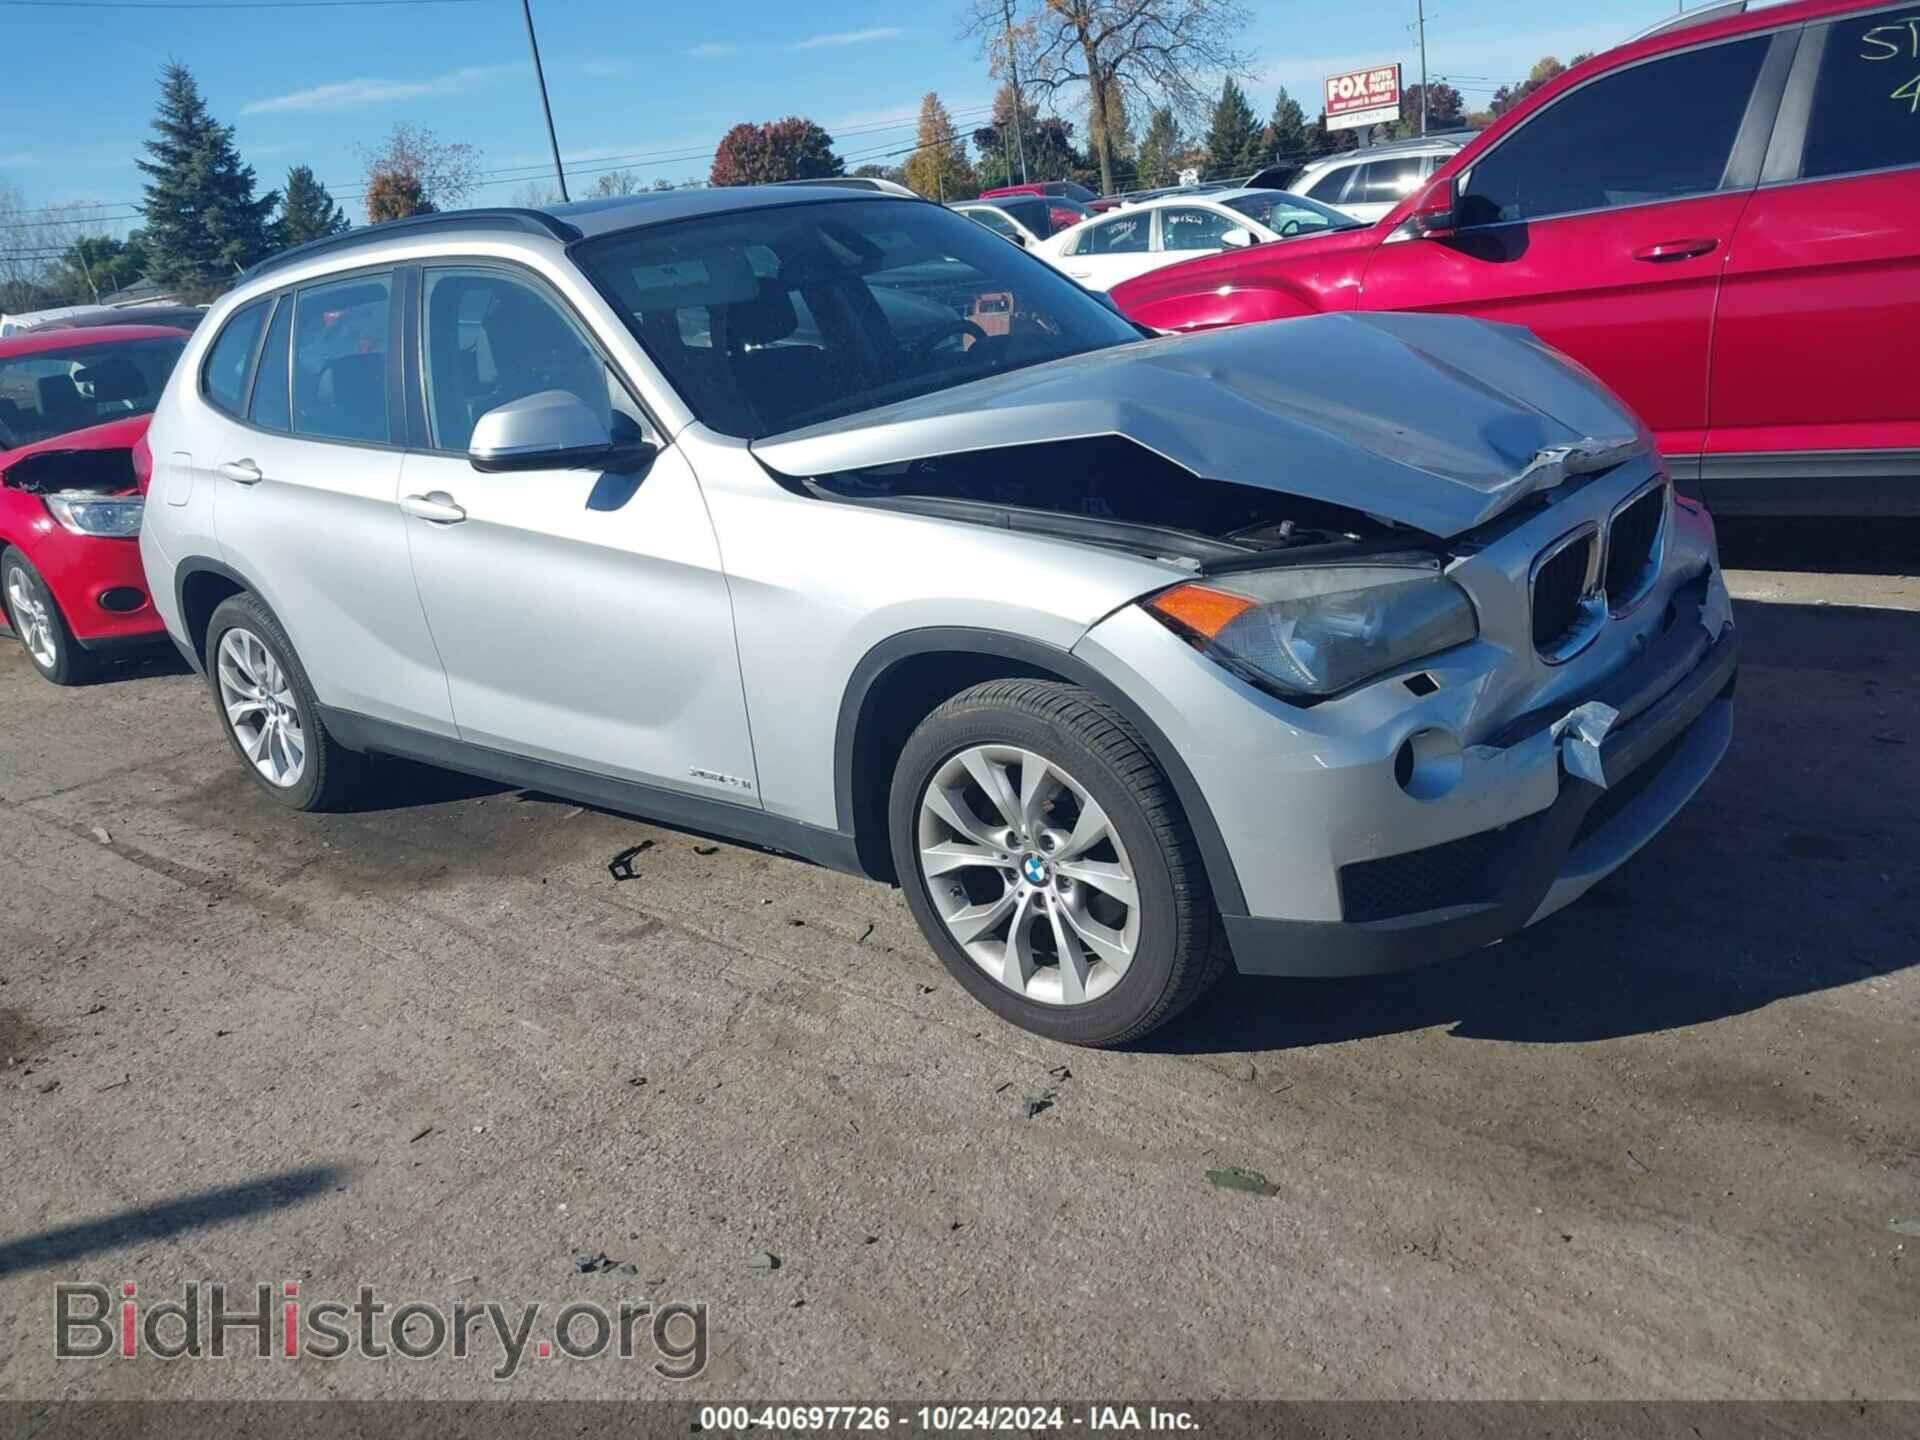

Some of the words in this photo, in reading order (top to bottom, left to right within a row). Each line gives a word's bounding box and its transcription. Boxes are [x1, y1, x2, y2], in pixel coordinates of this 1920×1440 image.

[1369, 69, 1393, 82] AUTO
[1328, 74, 1368, 101] FOX
[1369, 79, 1395, 94] PARTS
